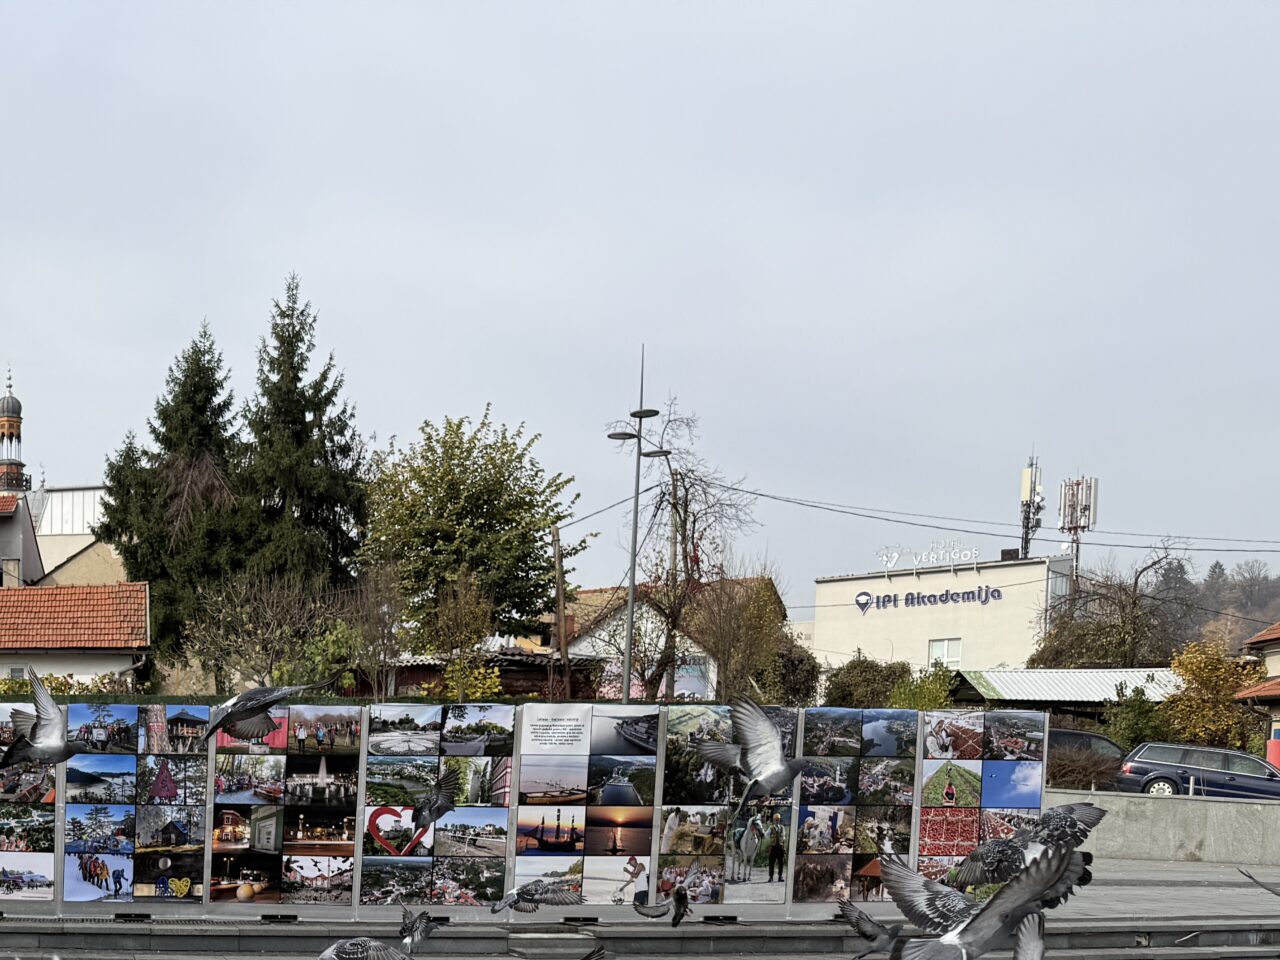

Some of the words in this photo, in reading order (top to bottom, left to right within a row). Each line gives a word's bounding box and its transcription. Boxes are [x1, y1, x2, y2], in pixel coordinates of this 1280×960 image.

[931, 539, 963, 550] HOTEL
[913, 548, 979, 566] VERTIGOS
[875, 593, 899, 610] IPI
[904, 585, 1003, 608] Akademija
